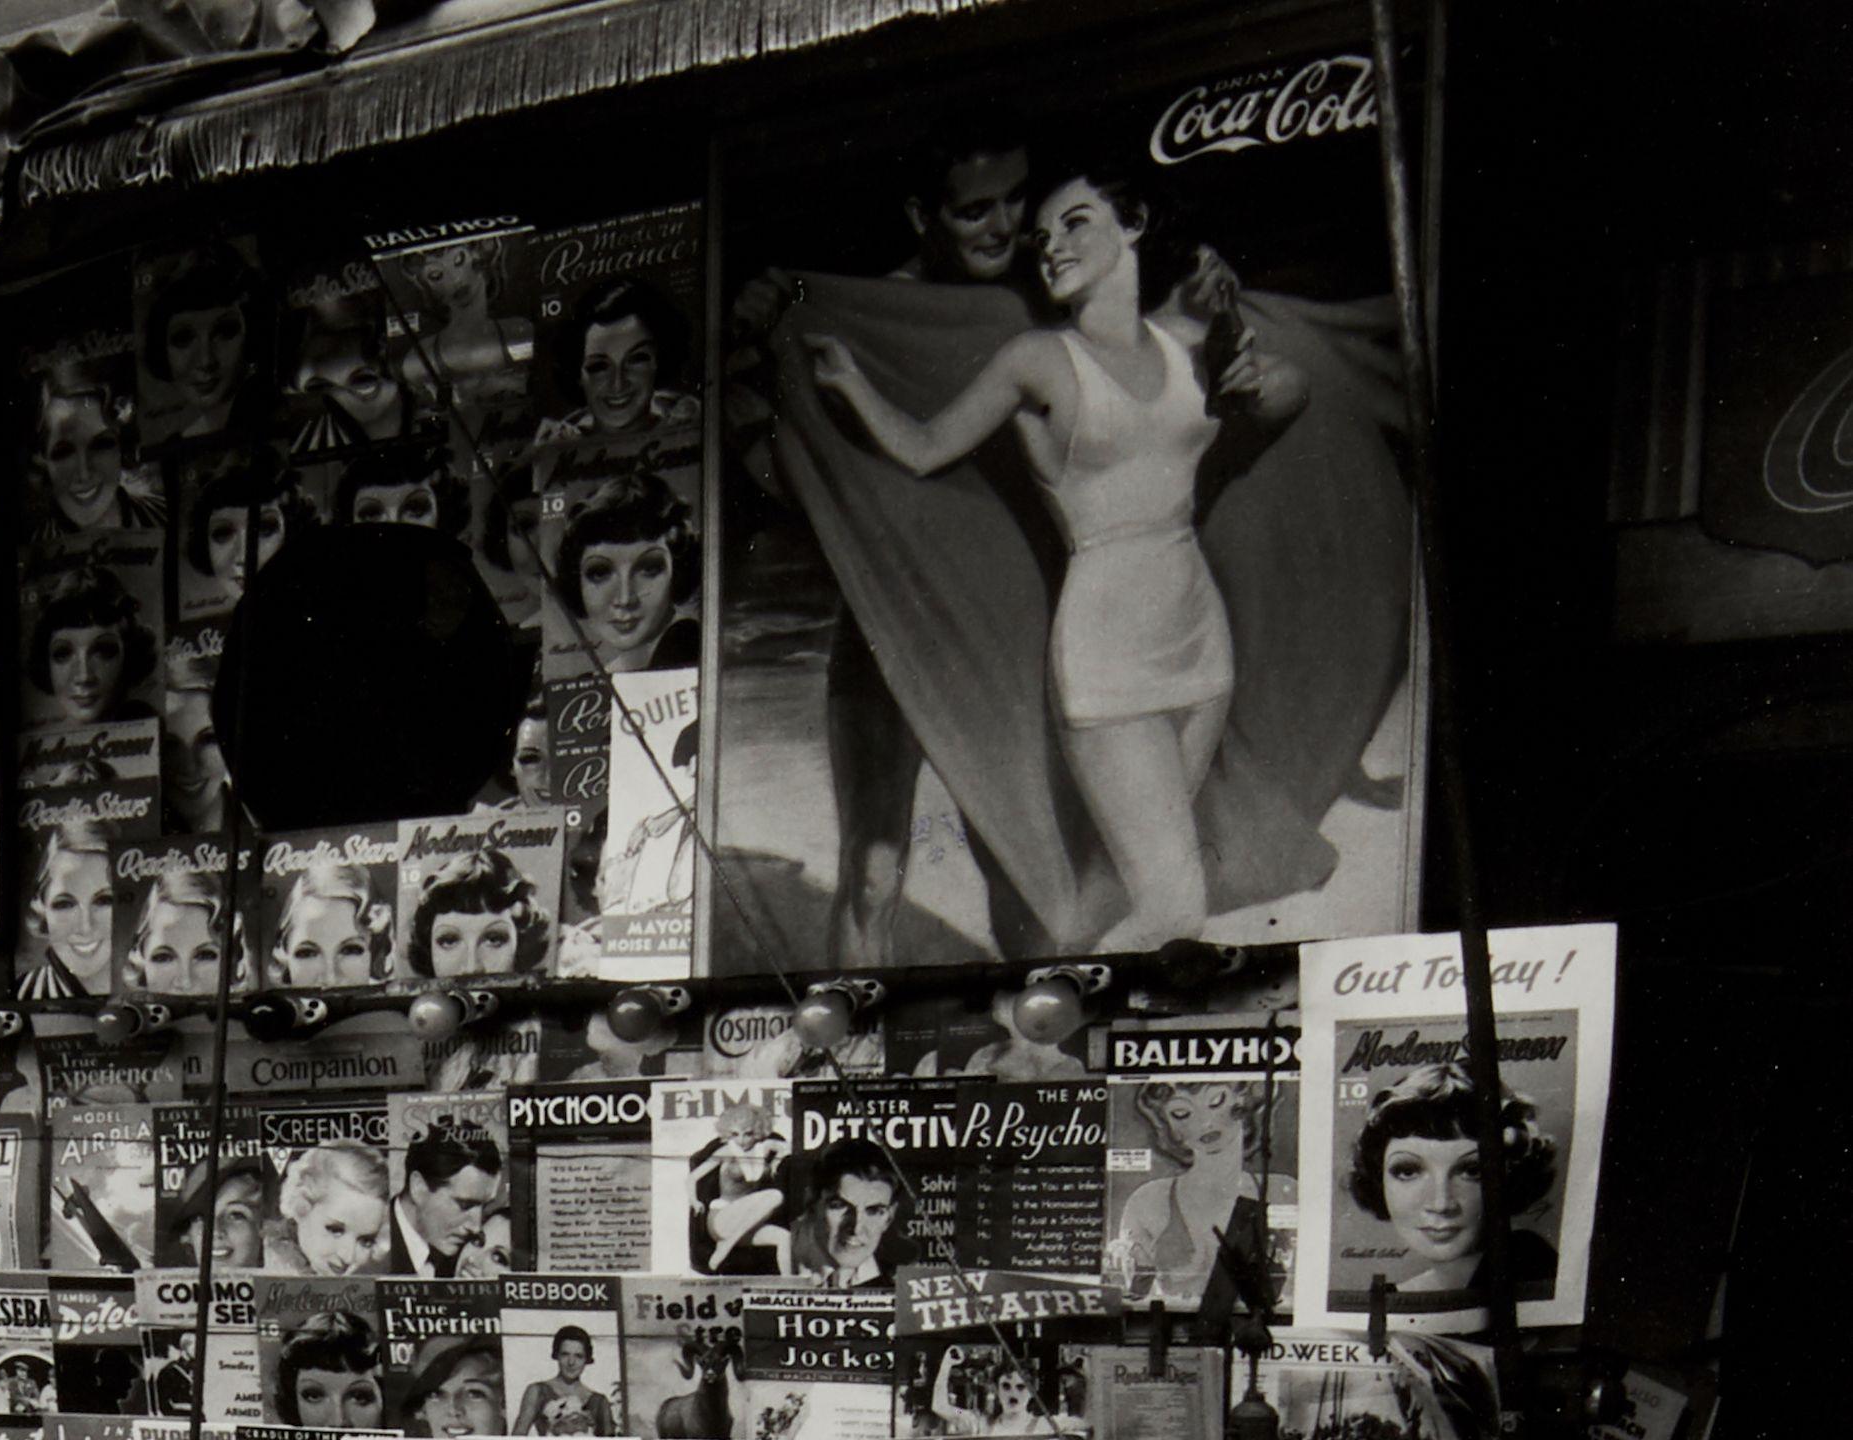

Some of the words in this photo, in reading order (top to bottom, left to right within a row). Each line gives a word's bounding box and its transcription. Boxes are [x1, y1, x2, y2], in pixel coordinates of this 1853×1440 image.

[541, 301, 561, 316] 10
[263, 841, 336, 874] Radio
[606, 939, 648, 953] NOISE
[1334, 960, 1409, 995] Out
[1343, 1031, 1462, 1072] Modern
[252, 1052, 398, 1086] Companion
[1037, 1089, 1067, 1102] THE
[1340, 1082, 1367, 1097] 10
[73, 1111, 122, 1124] MODEL
[509, 1094, 647, 1126] PSYCHOLO
[264, 1111, 345, 1146] SCREEN
[505, 1282, 608, 1300] REDBOOK
[636, 1293, 716, 1321] Field
[913, 1290, 1105, 1331] THEATRE
[224, 1406, 262, 1418] ARMED
